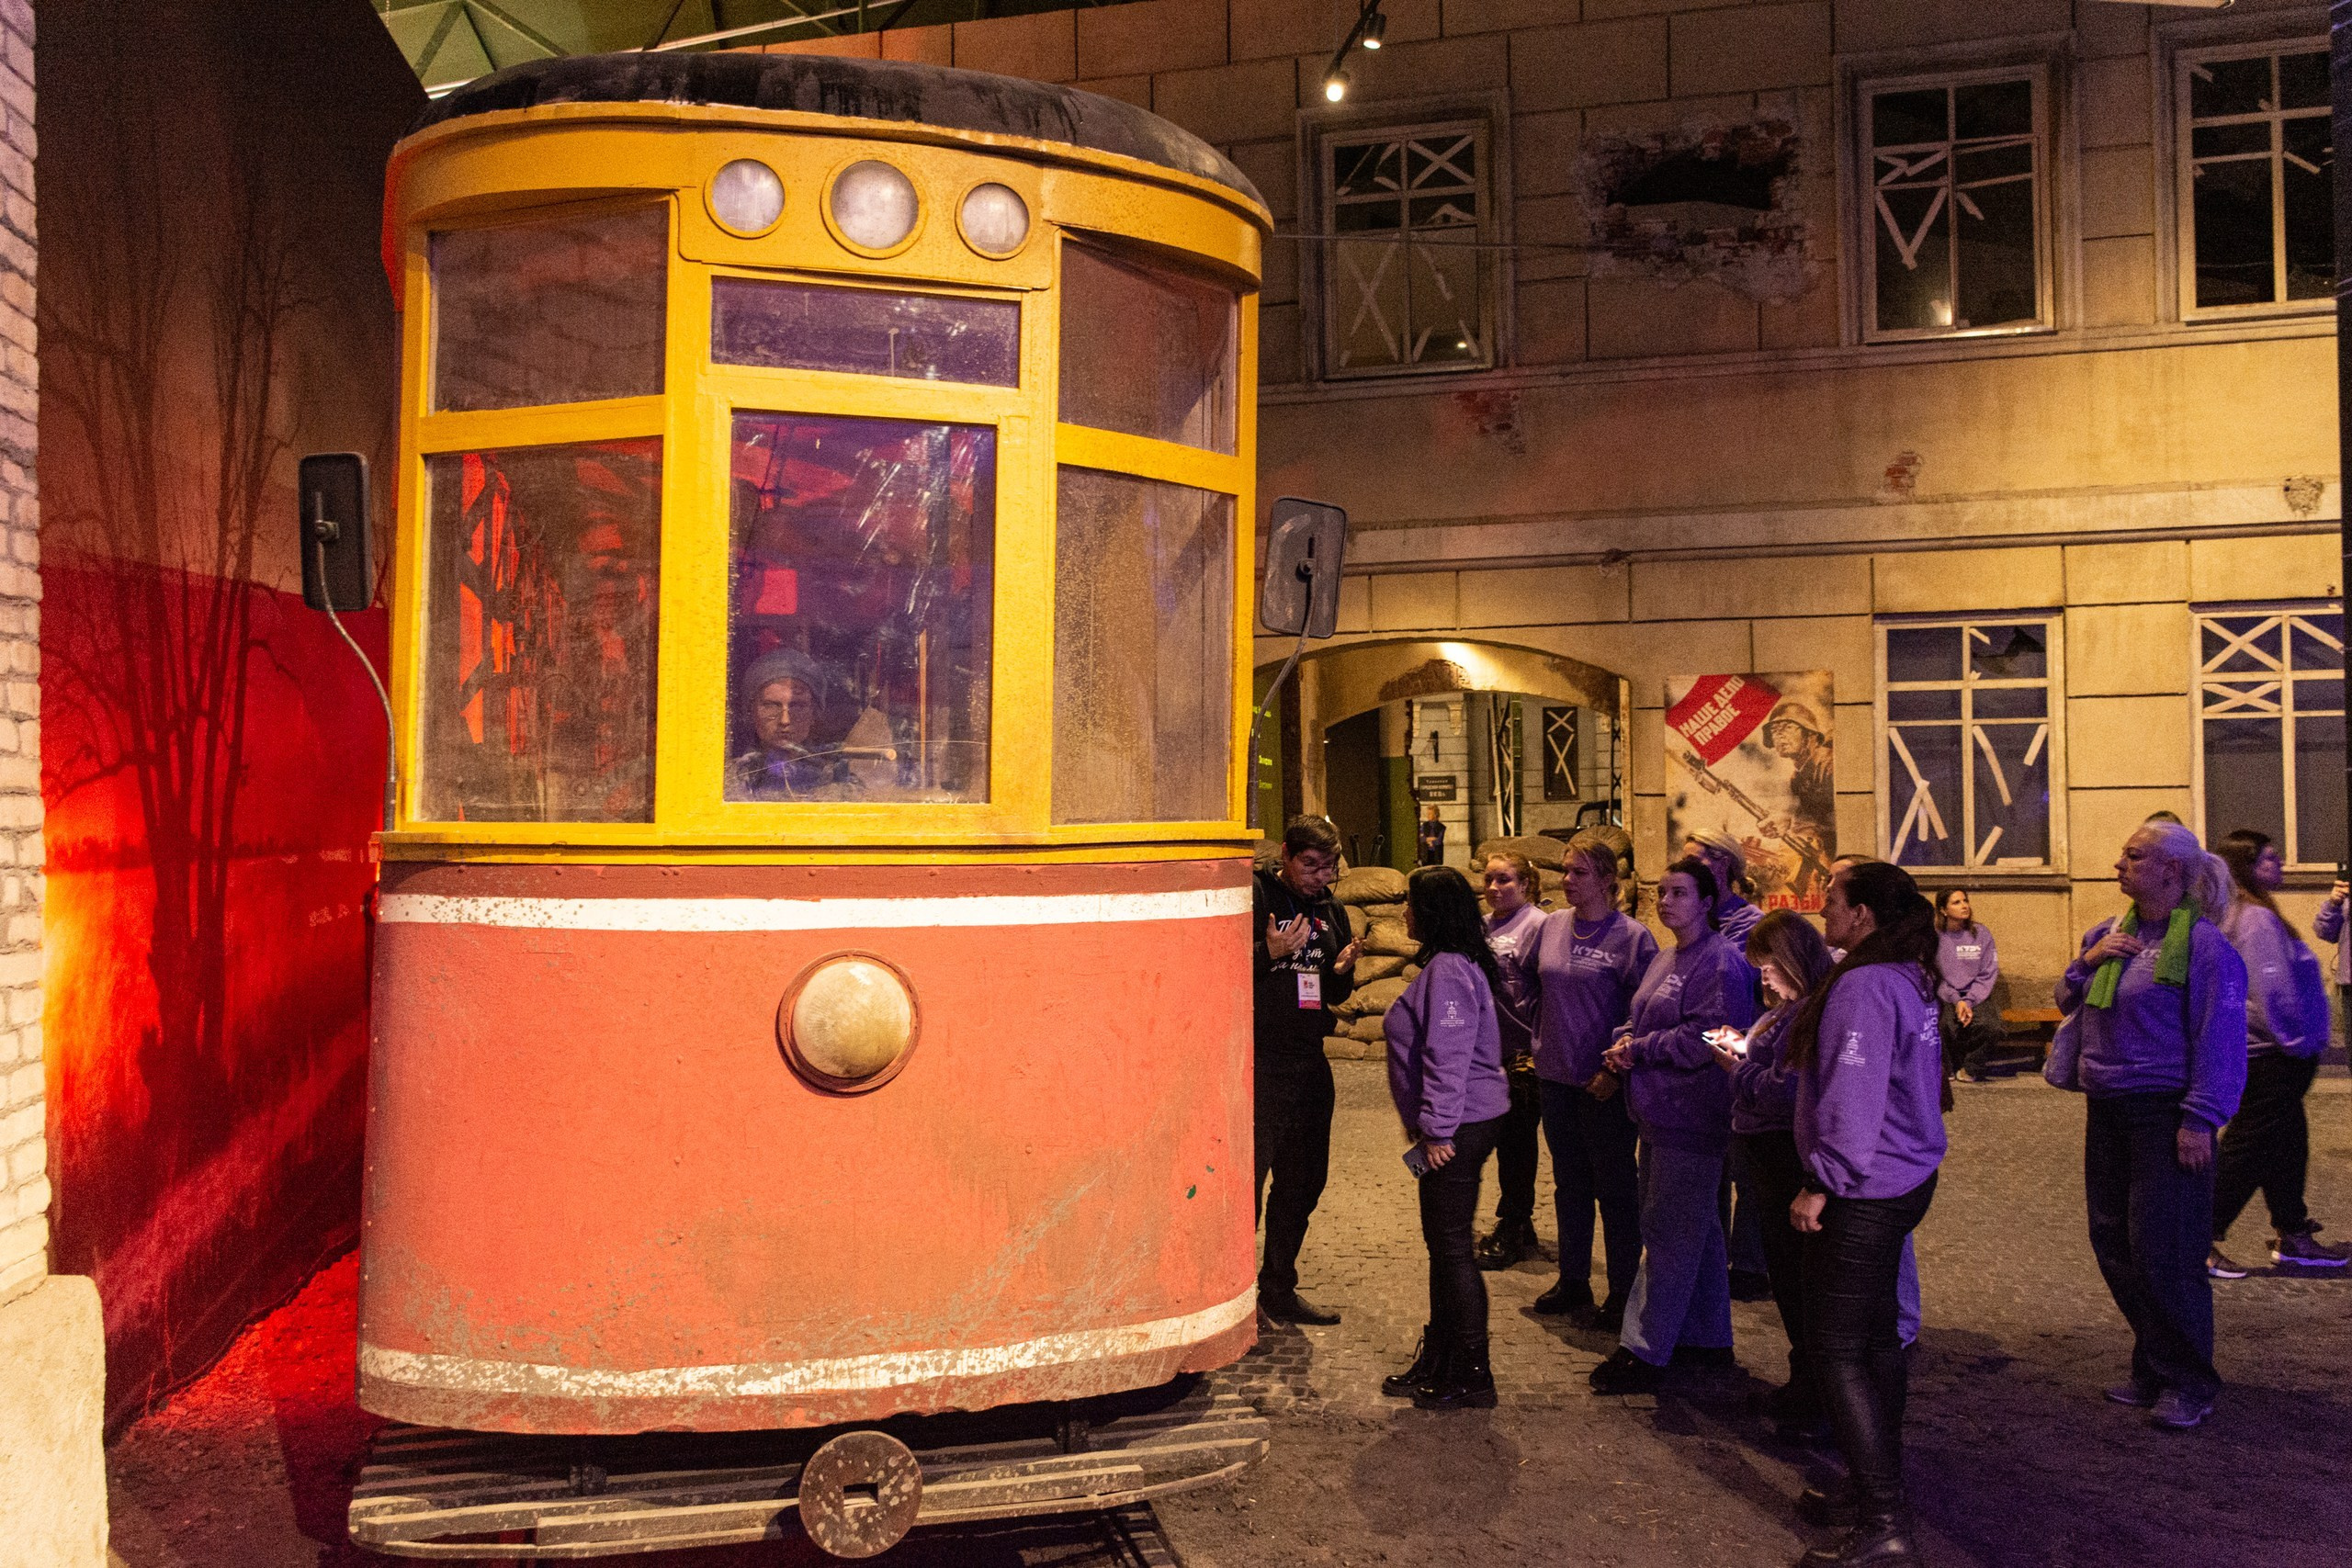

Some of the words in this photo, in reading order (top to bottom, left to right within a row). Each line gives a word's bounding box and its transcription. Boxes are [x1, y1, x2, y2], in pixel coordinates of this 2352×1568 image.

[1679, 701, 1720, 739] НАШЕ
[1713, 675, 1746, 709] ДЕЛО
[1693, 704, 1741, 746] ПРАВОЕ
